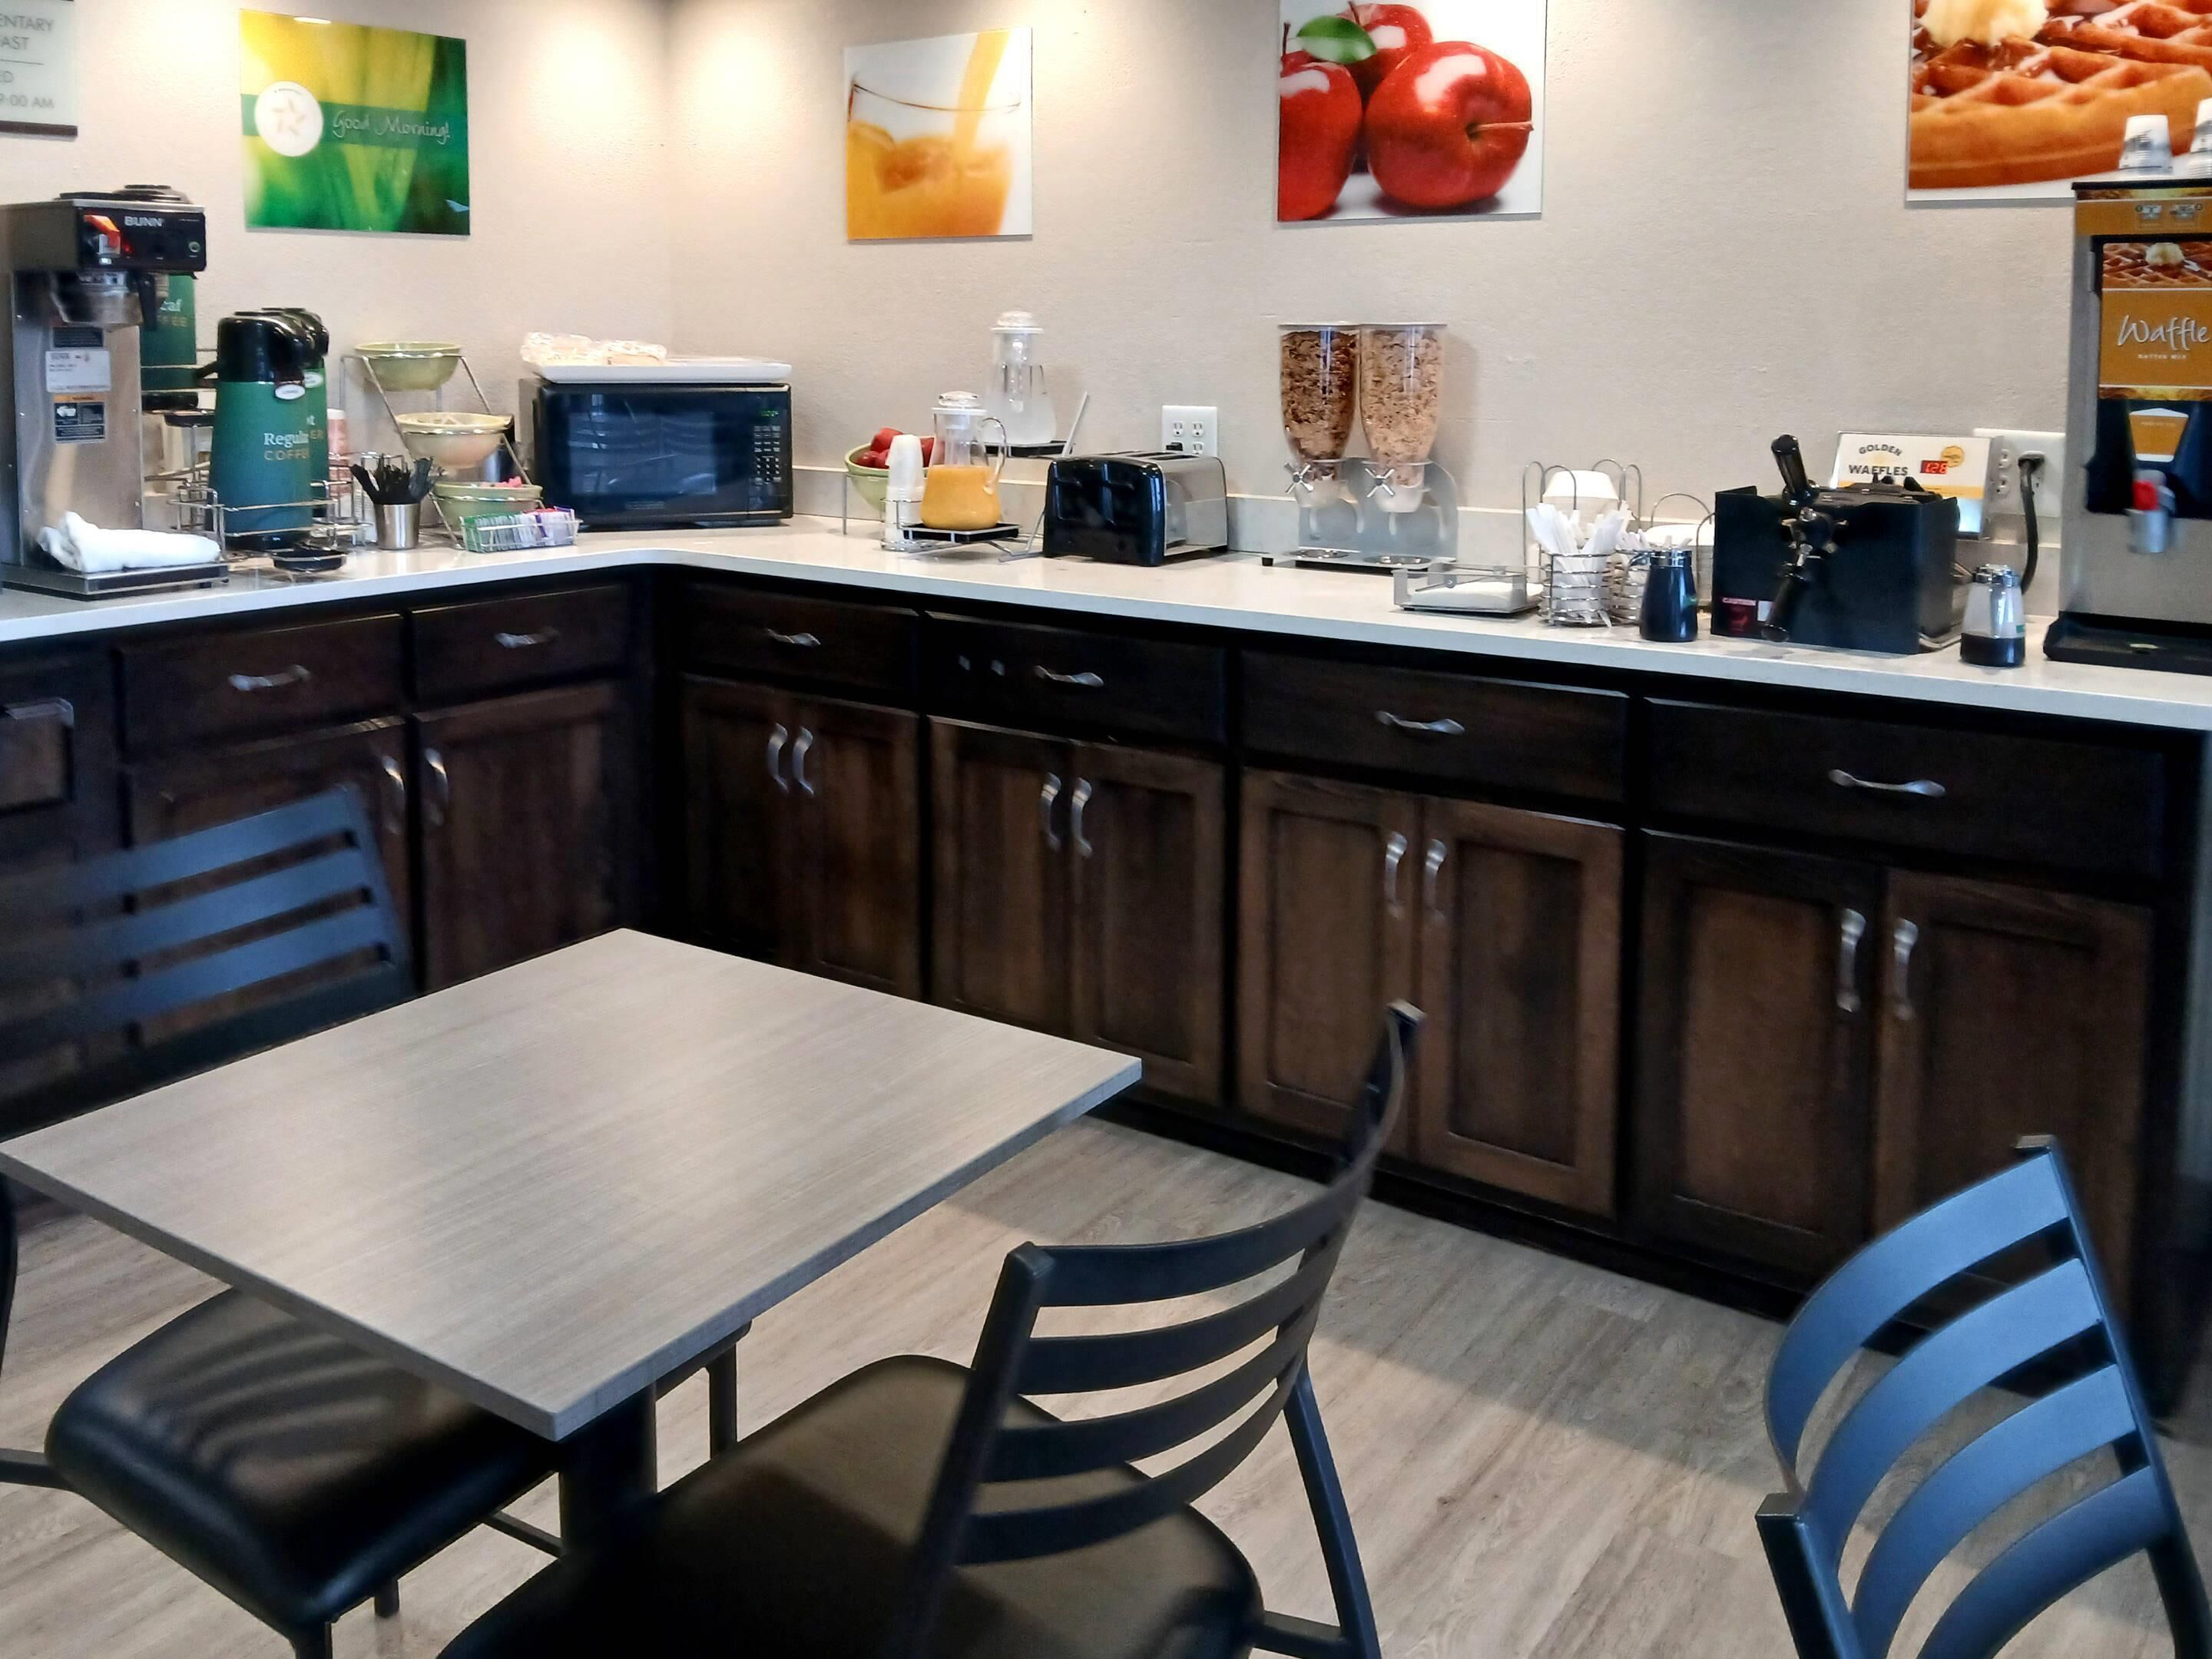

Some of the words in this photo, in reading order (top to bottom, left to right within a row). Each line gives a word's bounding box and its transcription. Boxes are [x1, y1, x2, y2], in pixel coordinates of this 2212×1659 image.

[31, 97, 55, 108] AM
[332, 110, 370, 138] Good
[124, 216, 163, 227] BUNN
[2117, 314, 2212, 352] Waffle
[1859, 444, 1903, 456] GOLDEN
[1848, 465, 1909, 476] WAFFLES
